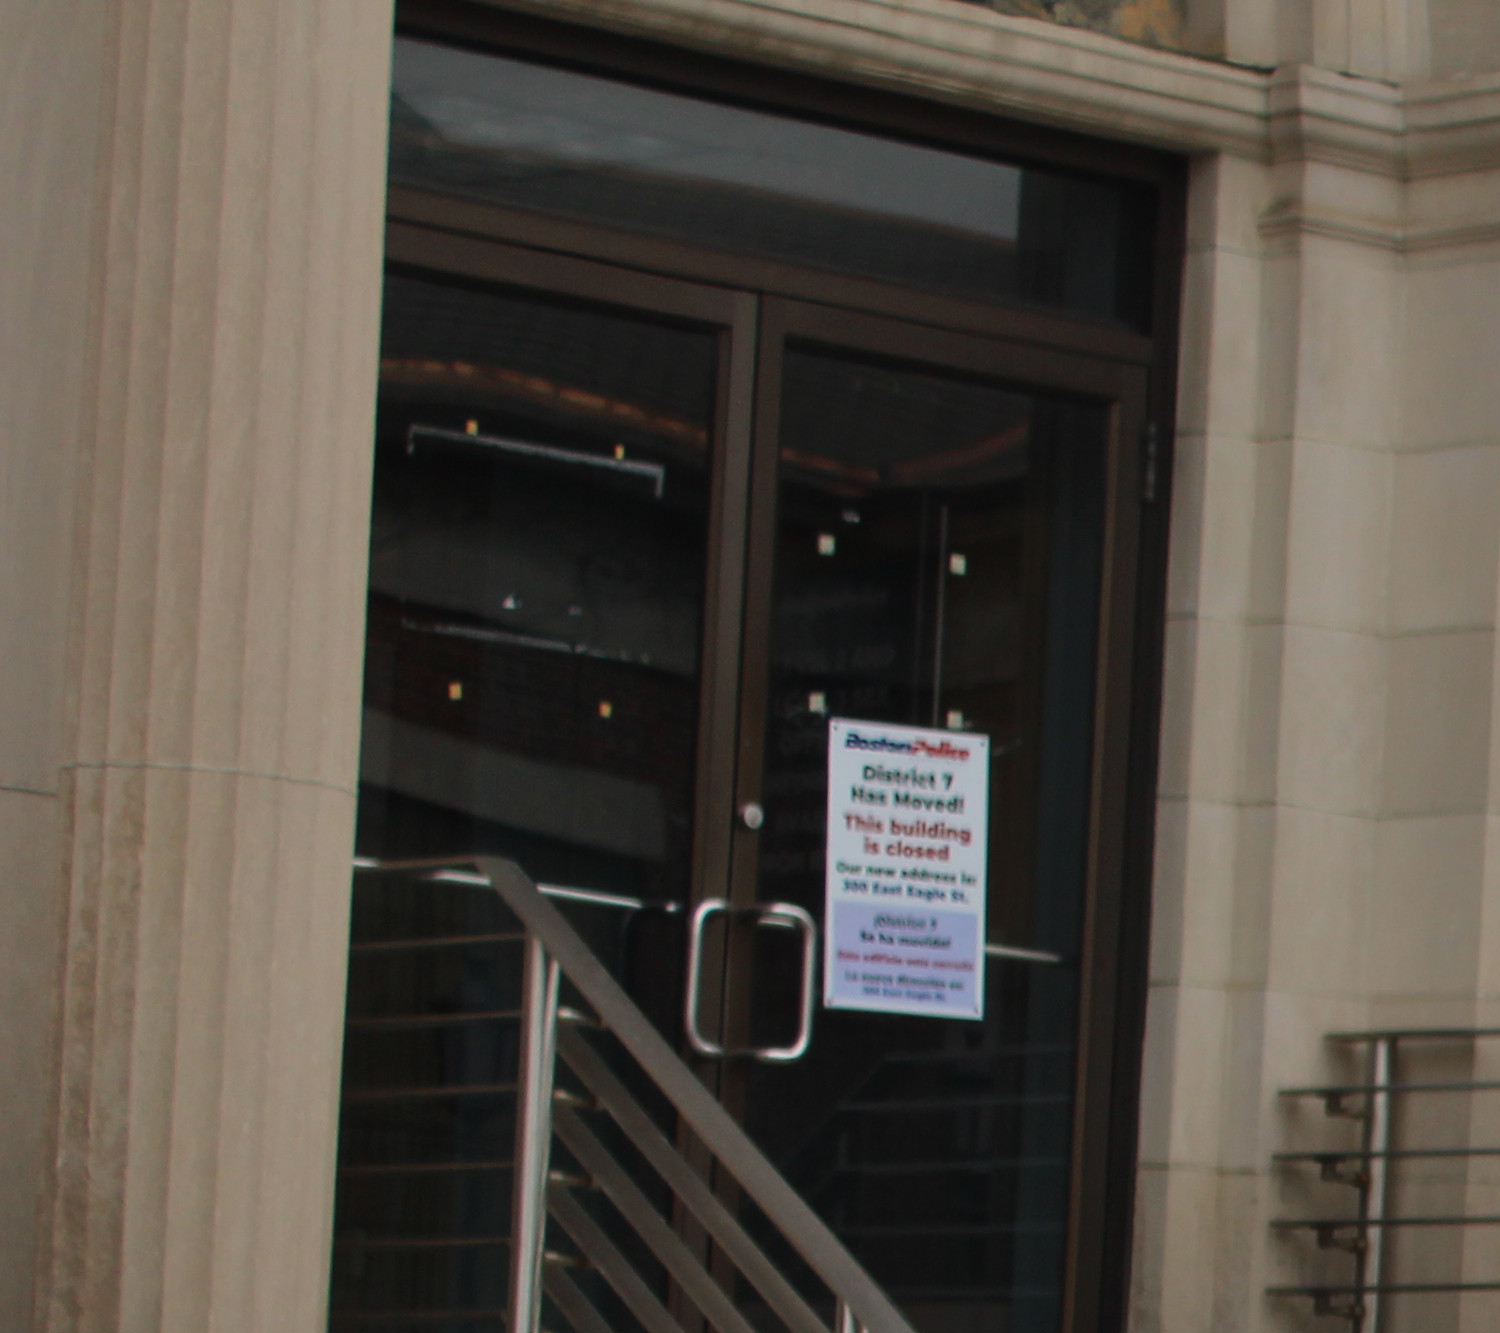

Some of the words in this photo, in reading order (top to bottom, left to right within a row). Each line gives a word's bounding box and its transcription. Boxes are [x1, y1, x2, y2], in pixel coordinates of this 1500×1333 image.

[862, 765, 935, 788] District
[942, 772, 953, 789] 7
[851, 785, 886, 804] Has
[893, 791, 964, 814] Moved!
[844, 813, 883, 831] This
[890, 819, 972, 845] building
[864, 837, 879, 854] is
[886, 841, 949, 862] closed
[836, 861, 861, 873] Our
[865, 865, 895, 877] new
[900, 868, 956, 882] address
[872, 882, 902, 895] East
[906, 885, 946, 901] Eagle
